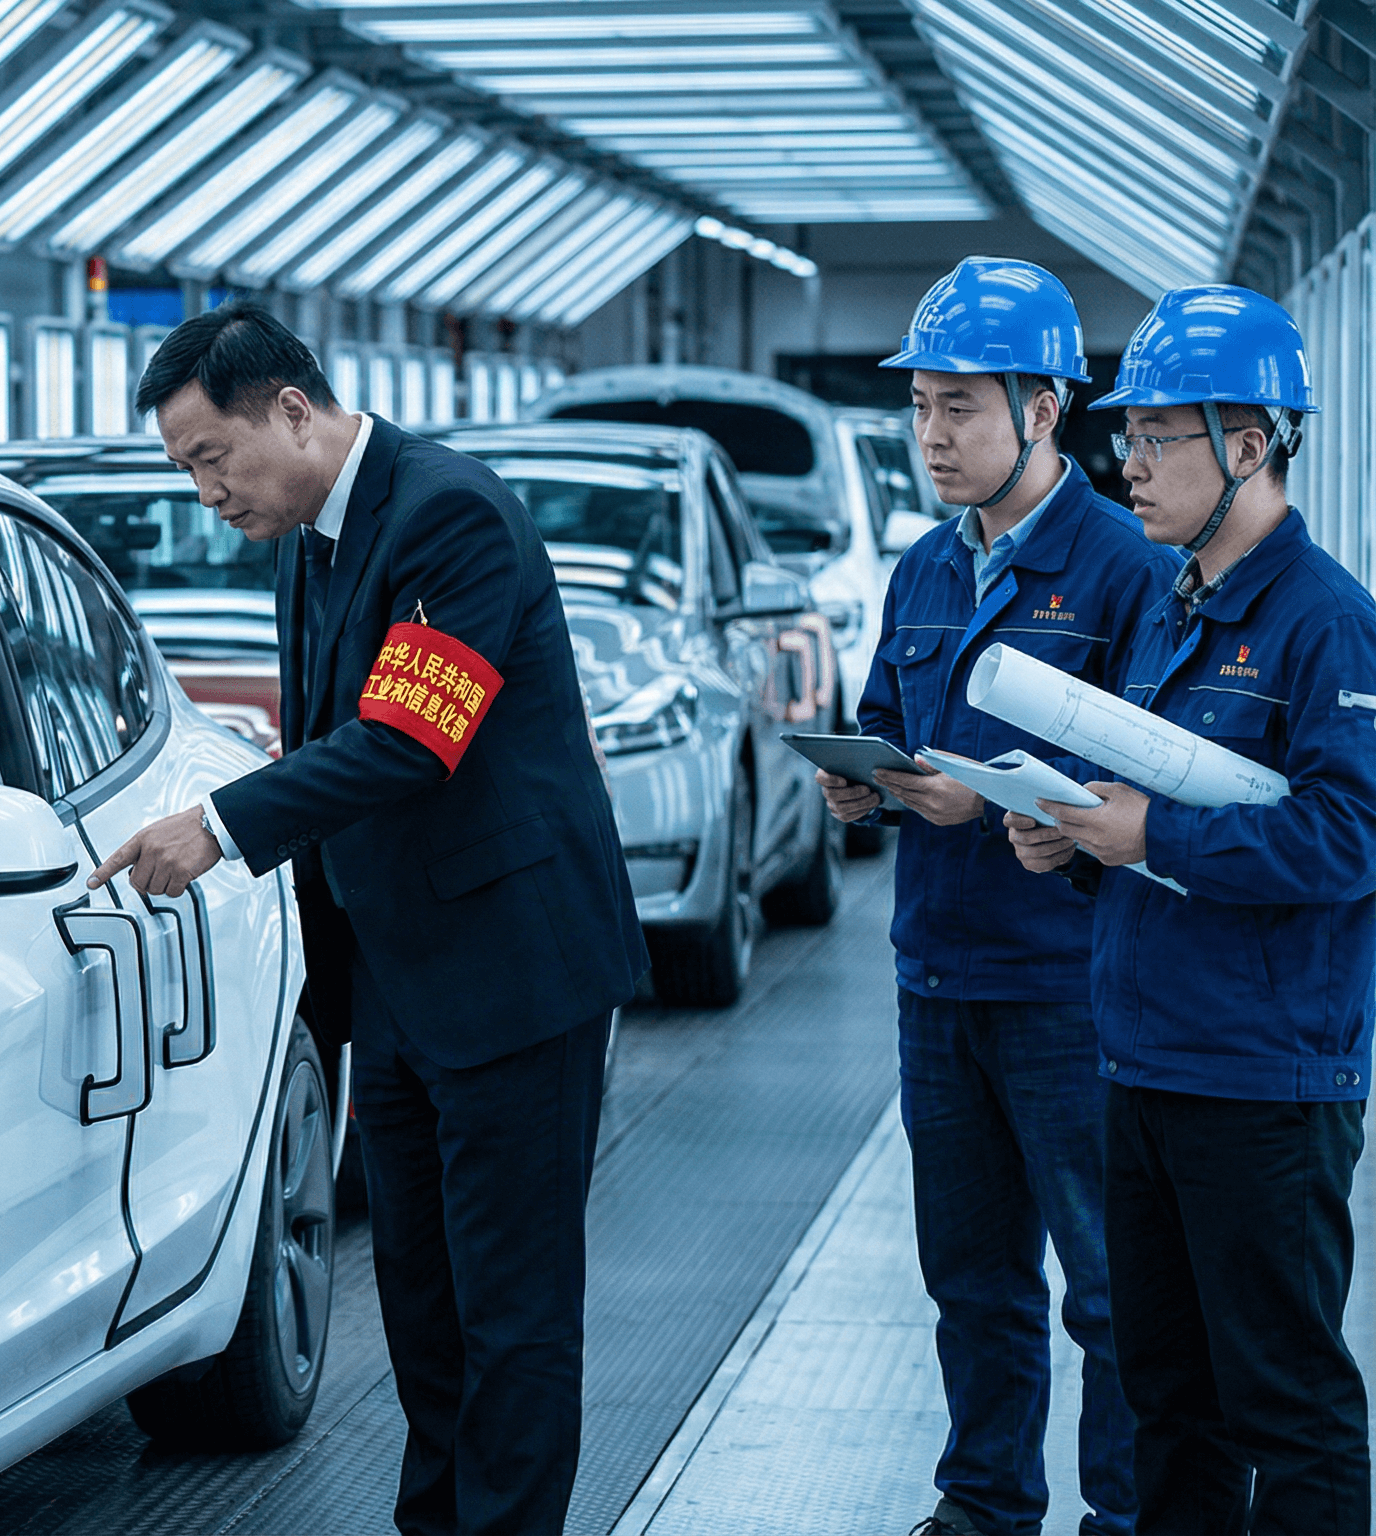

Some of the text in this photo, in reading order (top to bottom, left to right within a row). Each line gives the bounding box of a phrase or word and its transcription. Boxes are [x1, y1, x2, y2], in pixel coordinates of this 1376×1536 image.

[378, 640, 486, 718] 中华人民共和国
